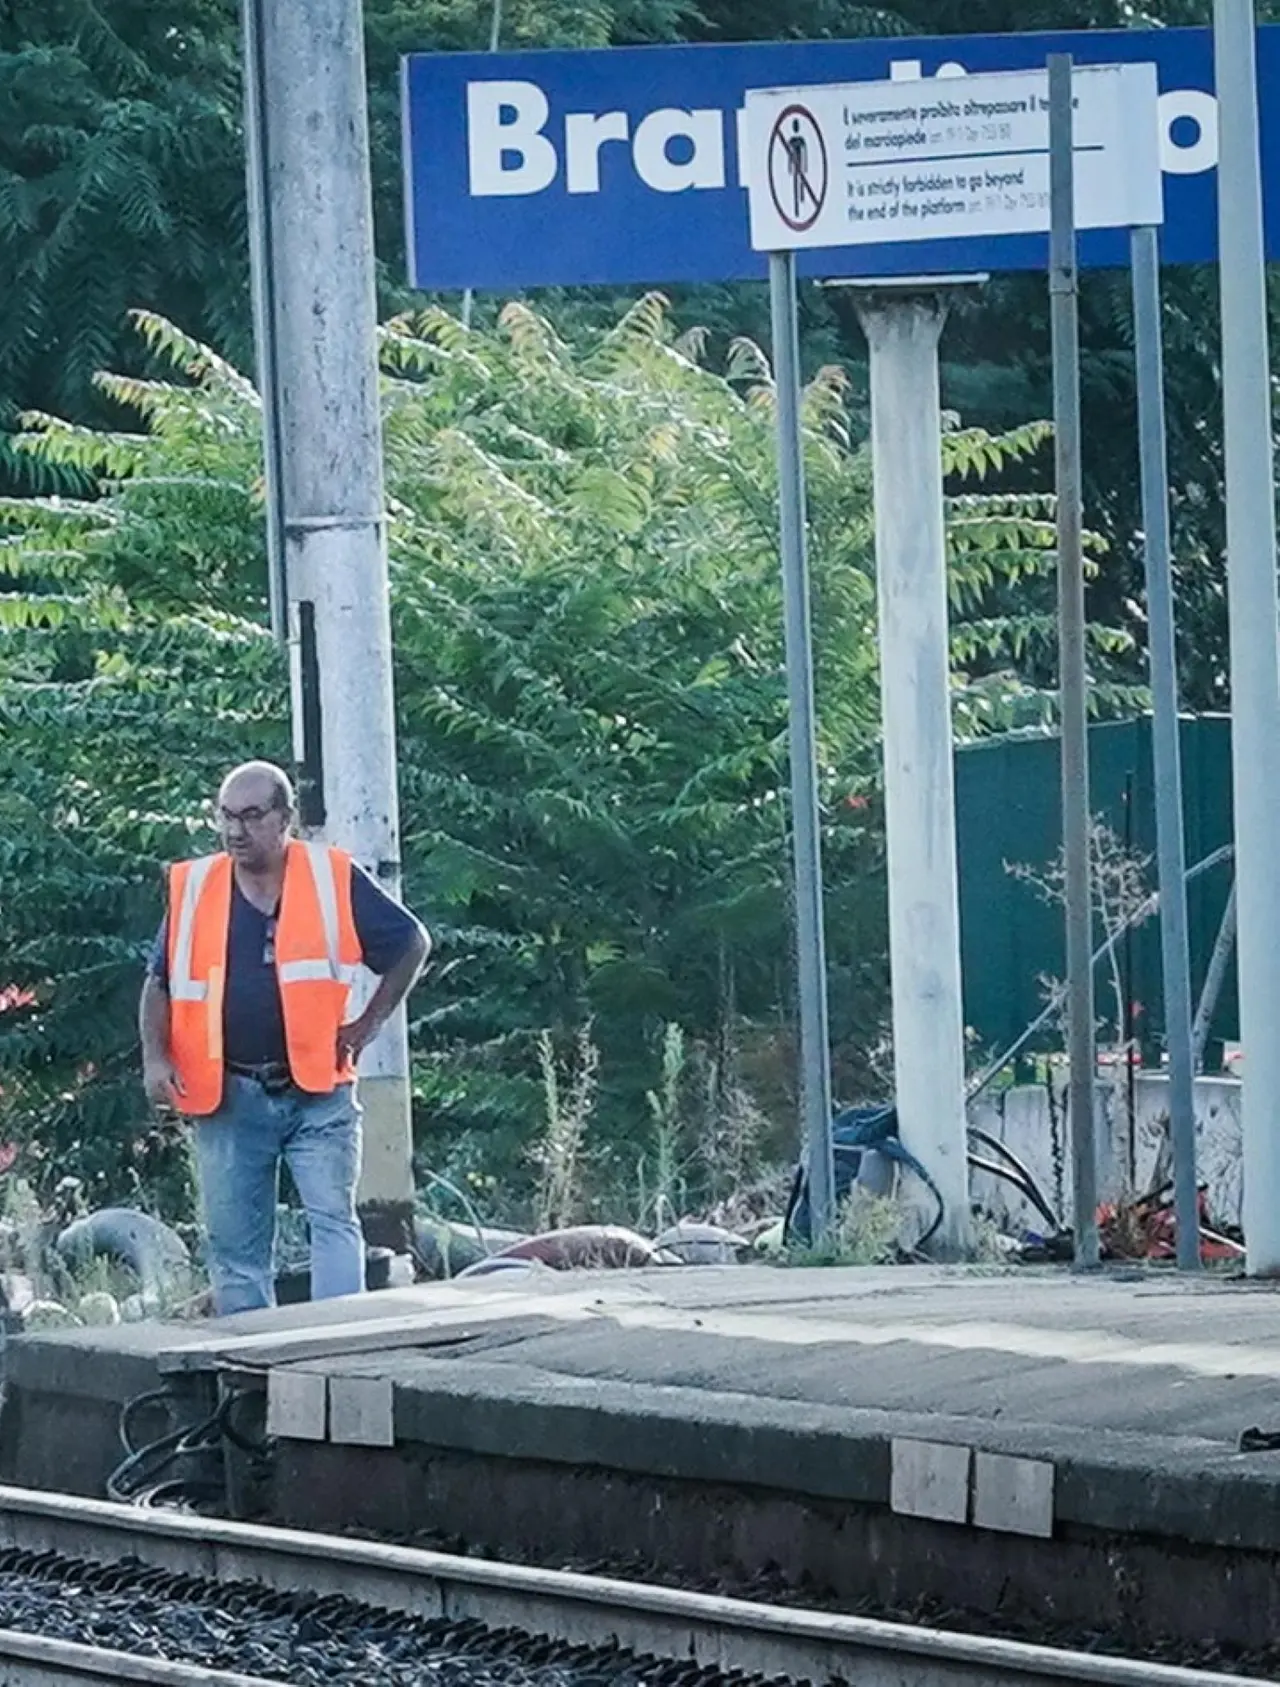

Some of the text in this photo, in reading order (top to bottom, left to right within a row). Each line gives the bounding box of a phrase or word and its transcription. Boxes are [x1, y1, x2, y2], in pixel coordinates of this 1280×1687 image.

[963, 98, 1026, 118] oltrepassare
[844, 132, 860, 150] del
[863, 127, 927, 149] marciapiede
[847, 168, 1023, 198] It is strictly forbidden to go beyond
[848, 203, 864, 221] the
[868, 200, 886, 219] end
[889, 199, 899, 217] of
[901, 199, 917, 216] the
[922, 197, 965, 219] platform
